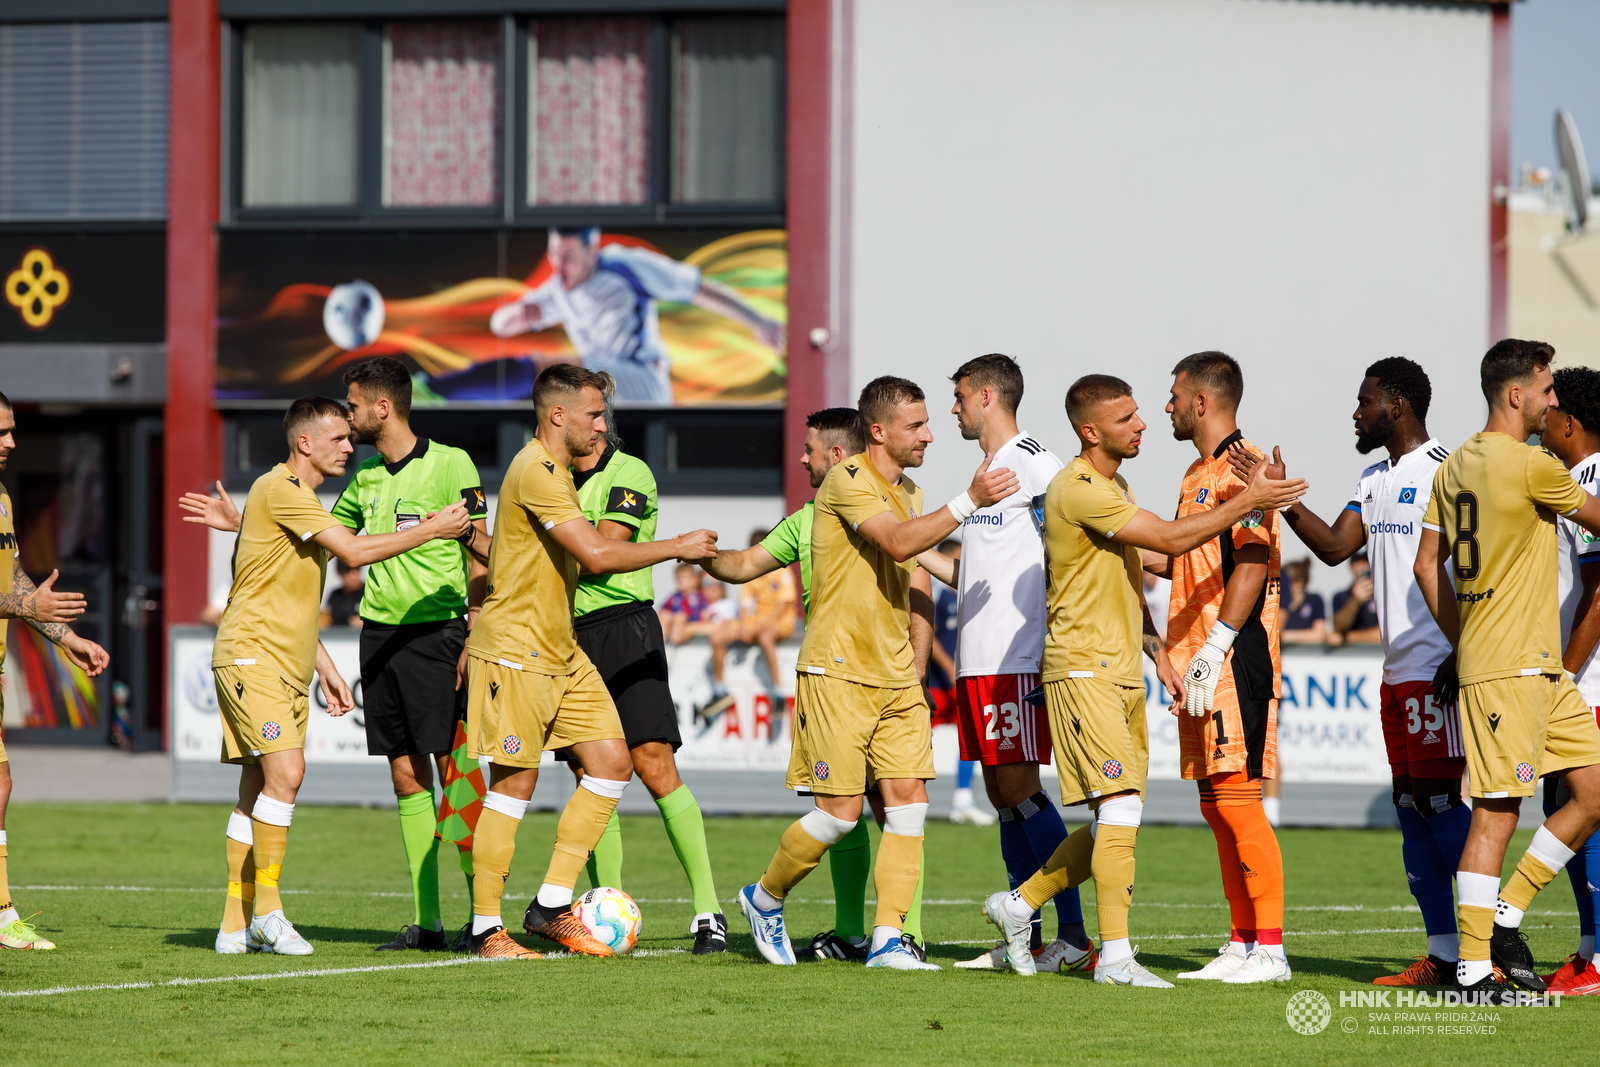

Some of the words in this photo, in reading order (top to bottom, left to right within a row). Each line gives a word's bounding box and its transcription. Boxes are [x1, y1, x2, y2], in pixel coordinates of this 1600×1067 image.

[1453, 490, 1481, 581] 8
[1280, 674, 1369, 709] ANK
[983, 701, 1020, 741] 23
[1211, 709, 1229, 747] 1
[1405, 694, 1444, 735] 35
